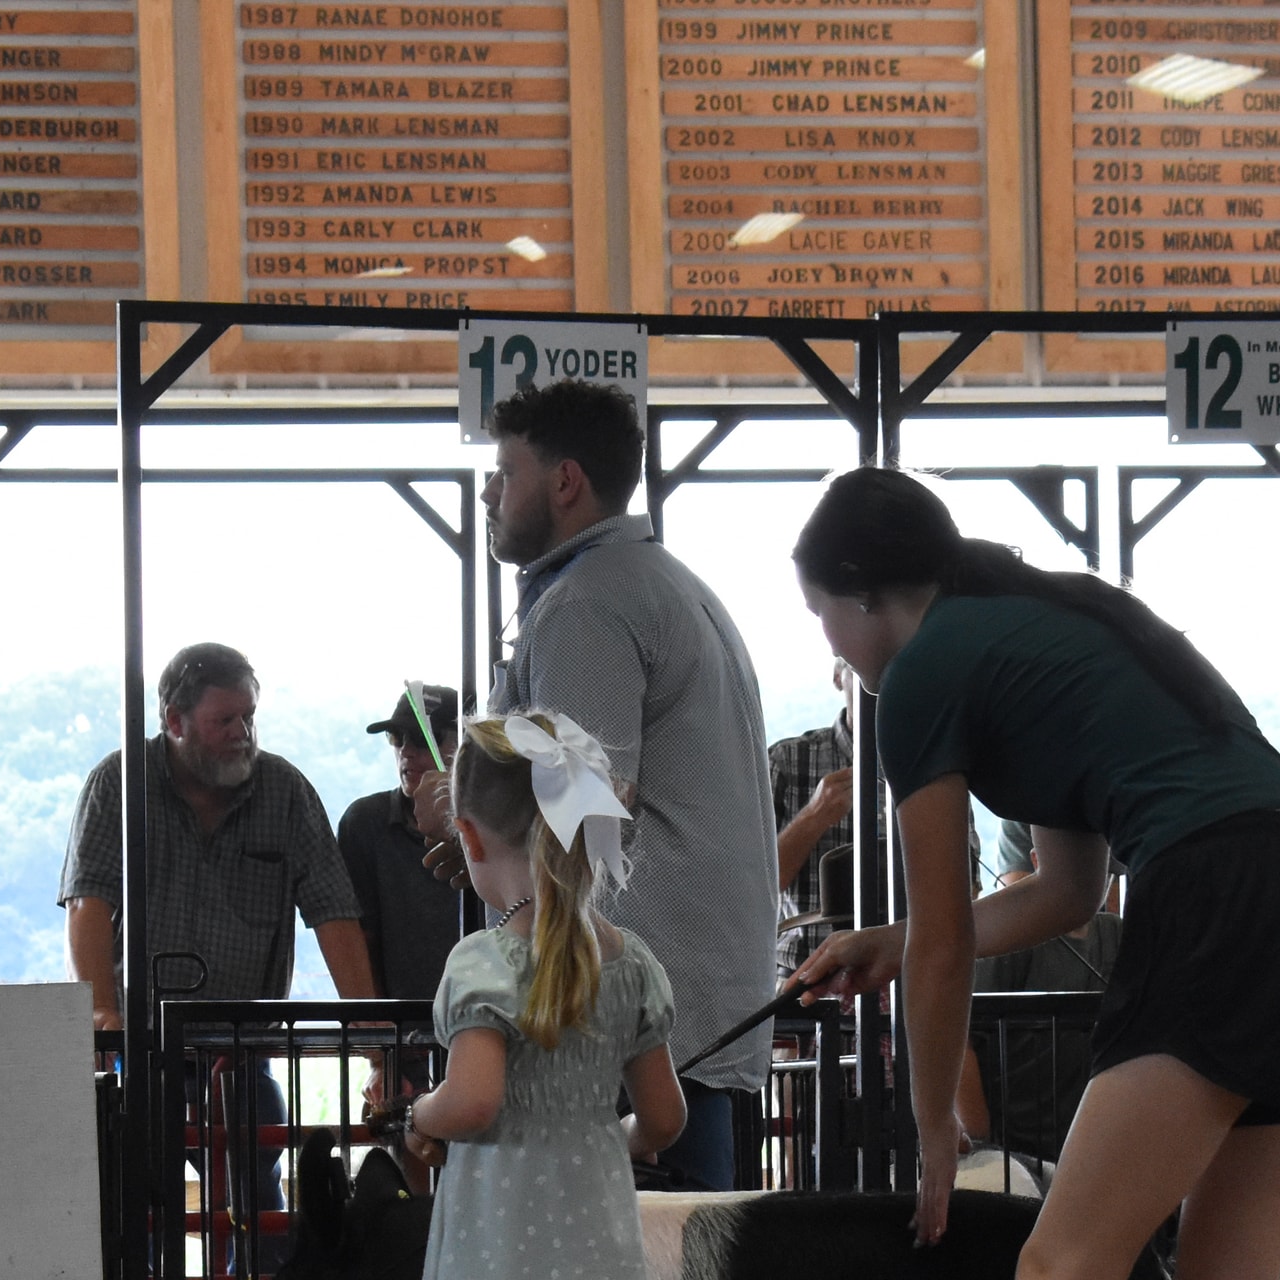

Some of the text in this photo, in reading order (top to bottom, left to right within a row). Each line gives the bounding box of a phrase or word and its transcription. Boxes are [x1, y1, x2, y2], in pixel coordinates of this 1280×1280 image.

[247, 8, 502, 28] 1987 RANAE DONOHOE
[666, 22, 892, 40] 1999 JIMMY PRINCE
[668, 59, 900, 77] 2000 JIMMY PRINCE
[251, 80, 512, 98] 1989 TAMARA BLAZER
[695, 95, 947, 112] 2001 CHAD LENSMAN
[252, 117, 499, 135] 1990 MARK LENSMAN
[679, 131, 916, 147] 2002 LISA KNOX
[1092, 128, 1141, 146] 2012
[1161, 129, 1201, 148] CODY
[252, 152, 486, 170] 1991 ERIC LENSMAN
[680, 165, 946, 181] 2003 CODY LENSMAN
[1093, 163, 1142, 181] 2013
[1163, 164, 1221, 182] MAGGIE
[254, 186, 497, 203] 1992 AMANDA LEWIS
[1092, 197, 1263, 217] 2014 JACK WING
[255, 221, 483, 238] 1993 CARLY CLARK
[1095, 231, 1144, 249] 2015
[1164, 232, 1233, 250] MIRANDA
[256, 258, 509, 274] 1994 MONICA PROPST
[688, 268, 913, 284] 2006 JOEY BROWN
[1095, 266, 1144, 283] 2016
[1164, 267, 1231, 285] MIRANDA
[1247, 341, 1261, 353] In
[544, 348, 637, 379] YODER
[1174, 334, 1243, 430] 12
